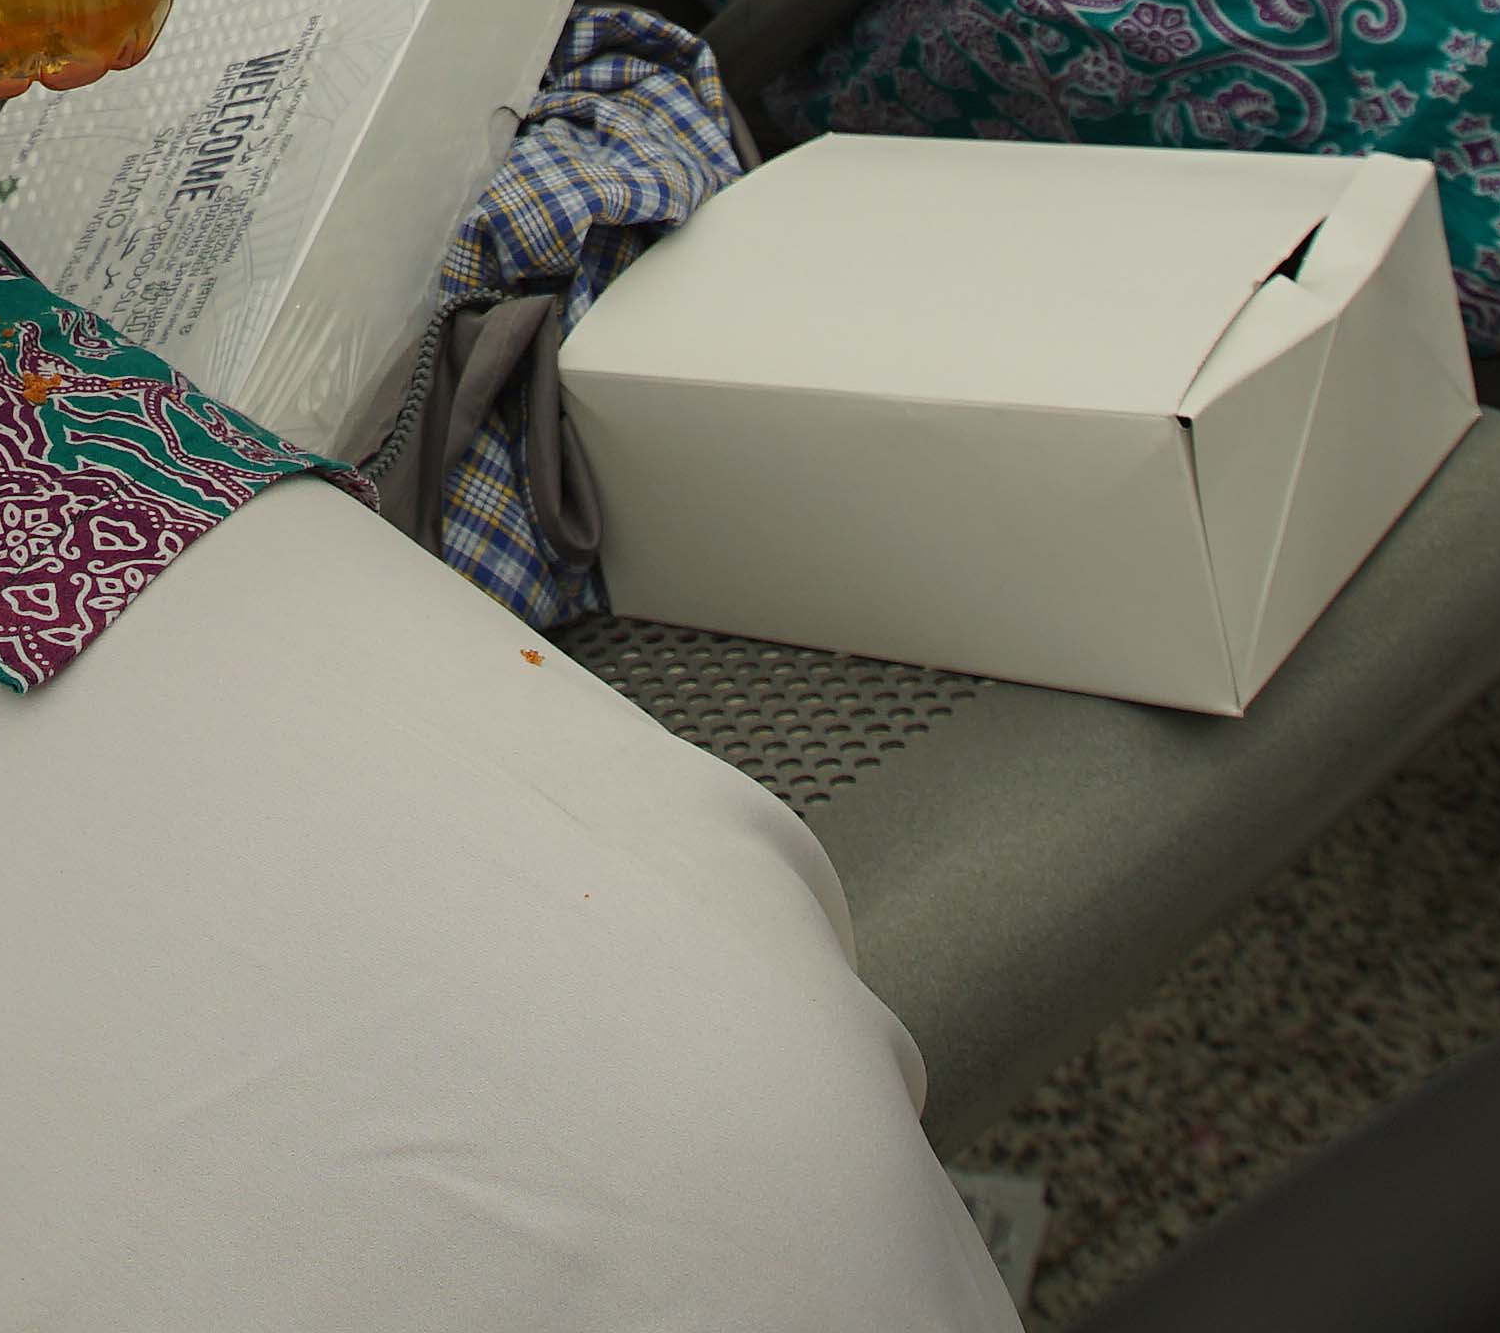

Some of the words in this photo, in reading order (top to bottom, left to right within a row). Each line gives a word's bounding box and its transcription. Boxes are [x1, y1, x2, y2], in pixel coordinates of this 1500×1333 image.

[168, 48, 291, 206] WELCOME
[175, 61, 243, 157] BIENVENUE
[101, 126, 177, 231] SALUTATIO
